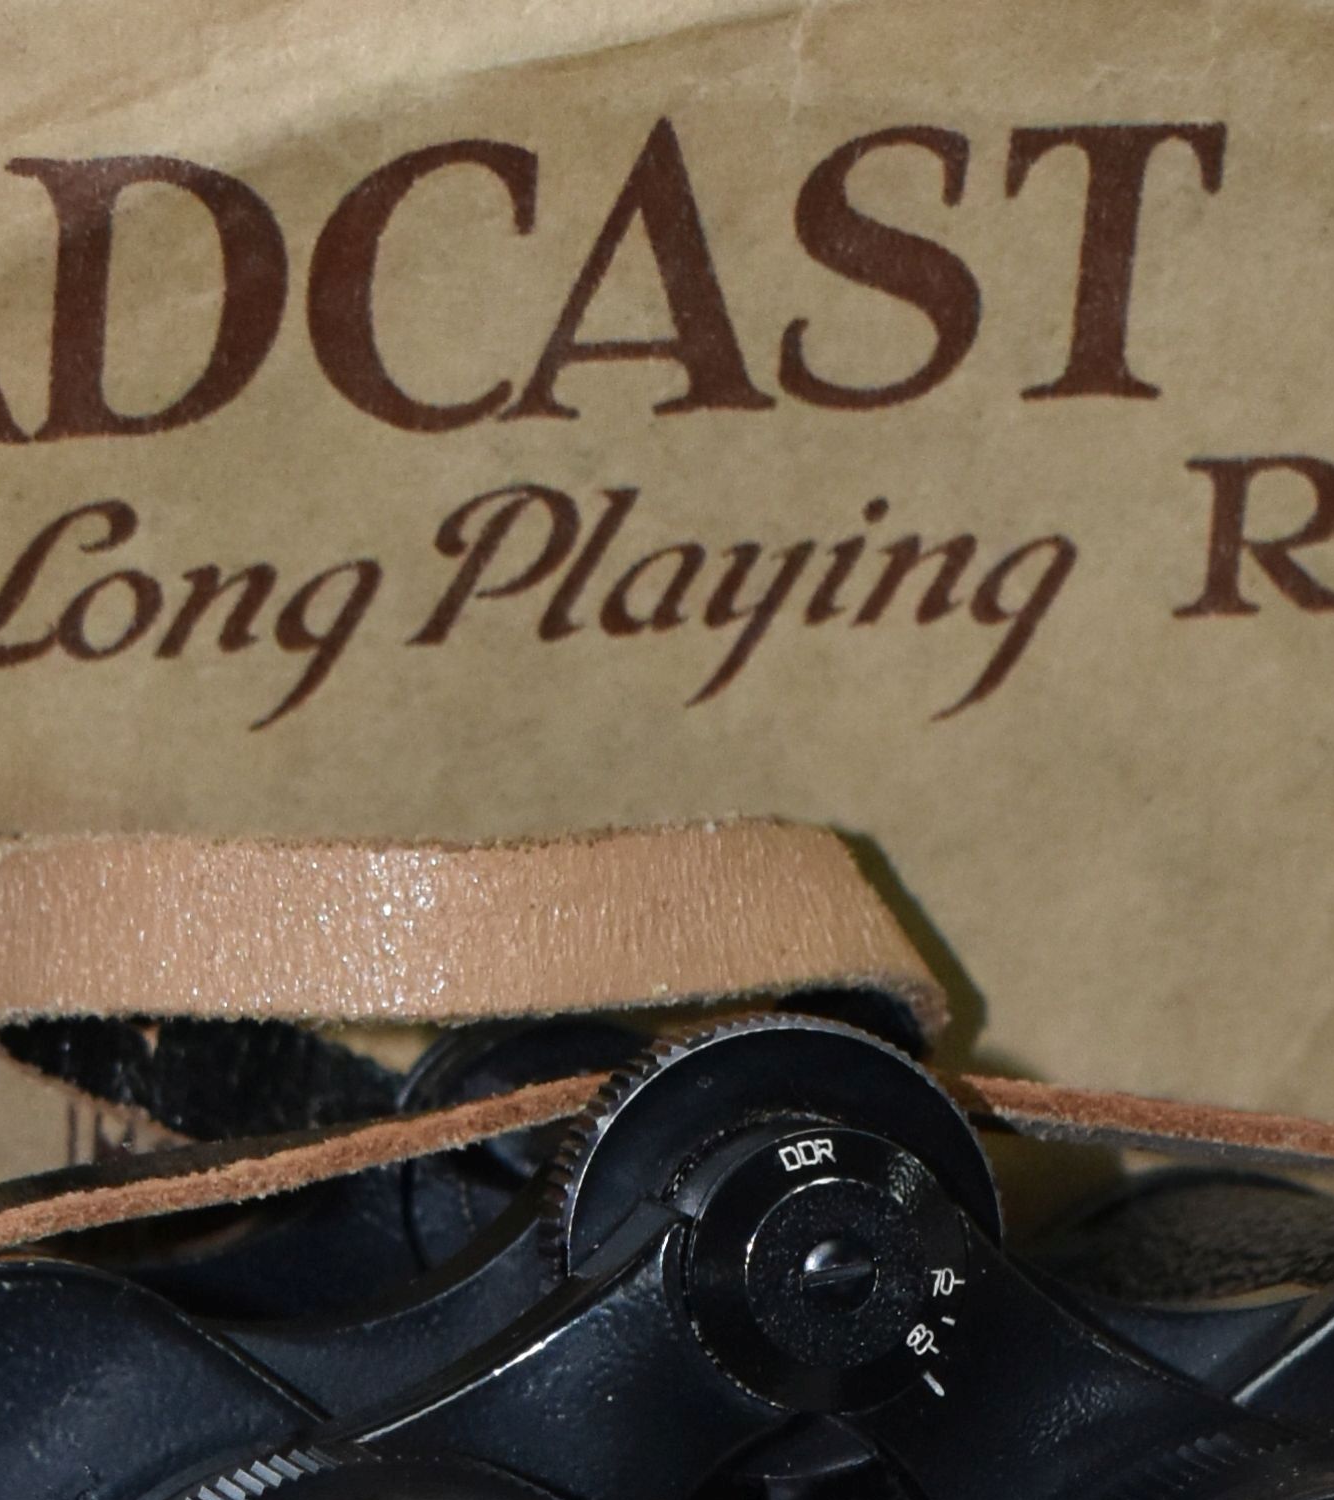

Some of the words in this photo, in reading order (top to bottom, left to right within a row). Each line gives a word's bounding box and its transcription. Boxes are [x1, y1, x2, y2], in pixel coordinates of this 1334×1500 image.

[407, 485, 1080, 724] Playing
[777, 1137, 837, 1173] DDR
[930, 1267, 955, 1297] 70
[905, 1322, 935, 1356] 60
